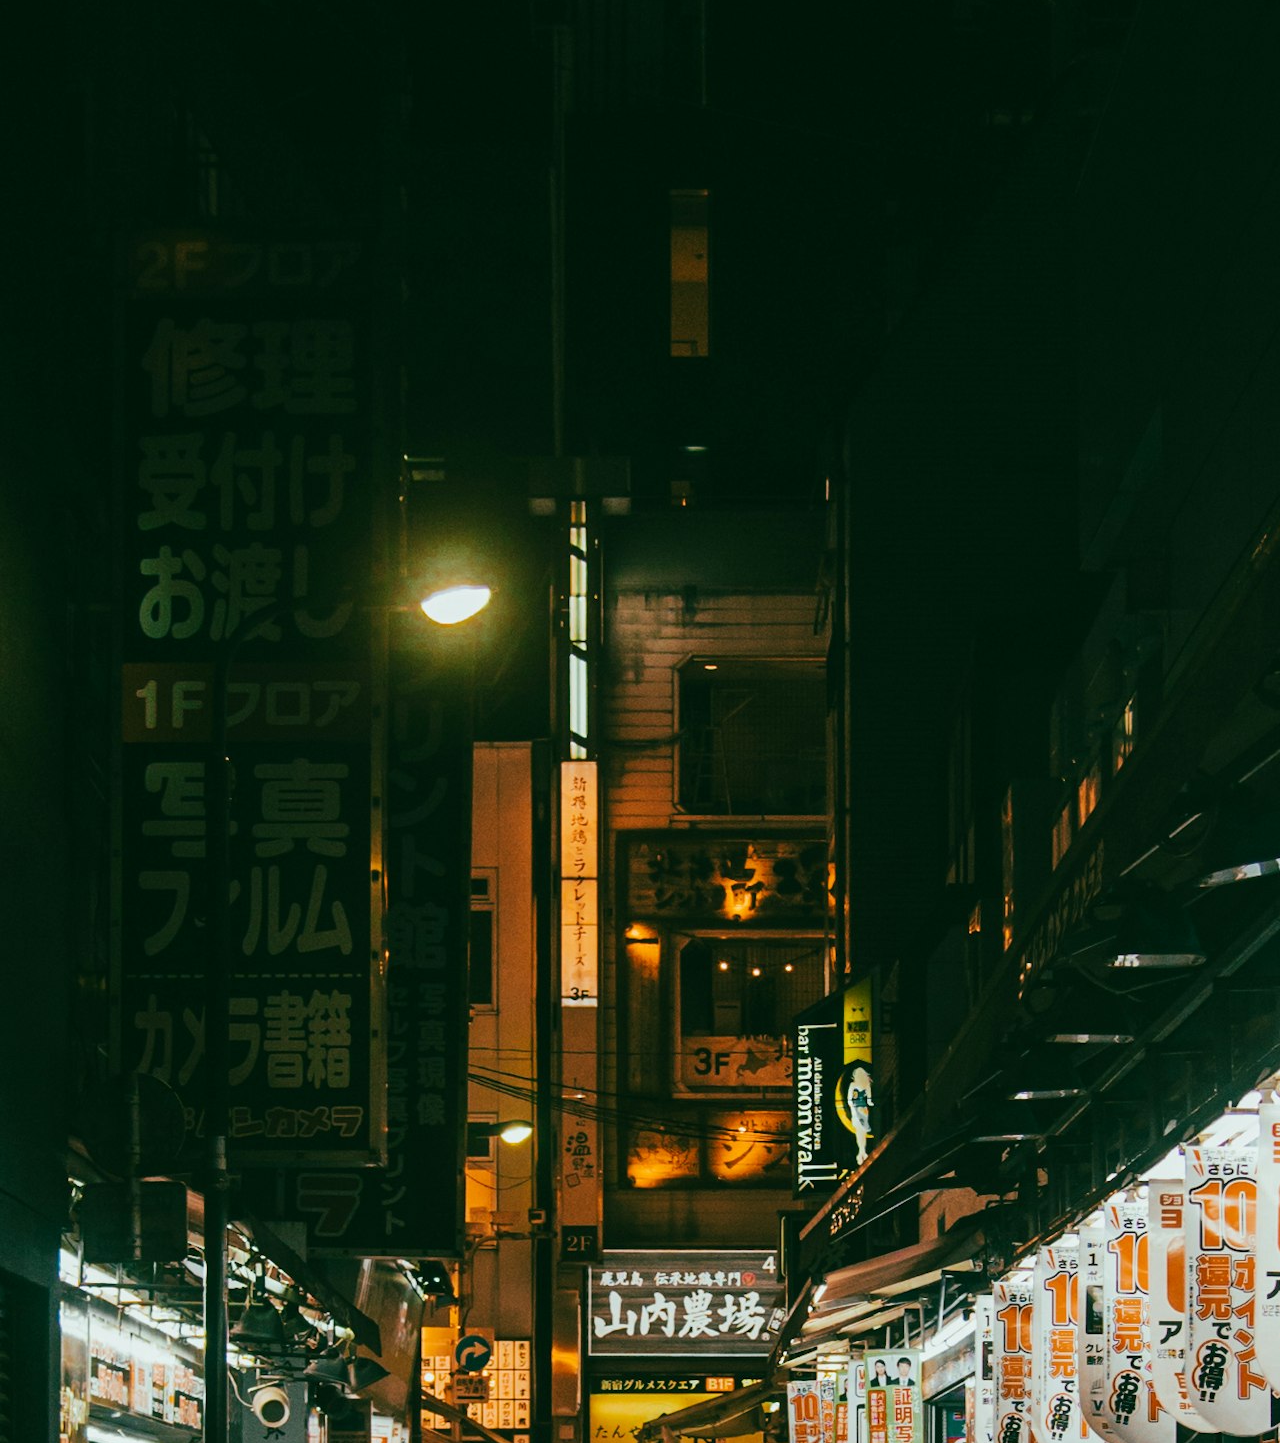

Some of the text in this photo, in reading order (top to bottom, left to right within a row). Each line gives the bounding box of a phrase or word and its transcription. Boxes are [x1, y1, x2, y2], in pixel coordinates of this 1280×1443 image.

[141, 316, 359, 418] 修理
[137, 431, 357, 531] 受付け
[138, 542, 355, 643] お渡し
[135, 678, 362, 730] 1Fフロア
[141, 758, 351, 857] 写真
[138, 864, 354, 957] フルム
[570, 987, 590, 1002] 3F
[694, 1047, 730, 1076] 3F
[797, 1023, 838, 1192] bar moon walk
[1207, 1162, 1250, 1176] さらに
[566, 1235, 593, 1253] 2F
[761, 1255, 777, 1274] 4
[599, 1271, 644, 1287] 鹿児島
[593, 1288, 766, 1341] 山内農場
[600, 1379, 700, 1391] 新宿グルメスクエア
[706, 1378, 734, 1391] B1F
[790, 1393, 819, 1423] 10
